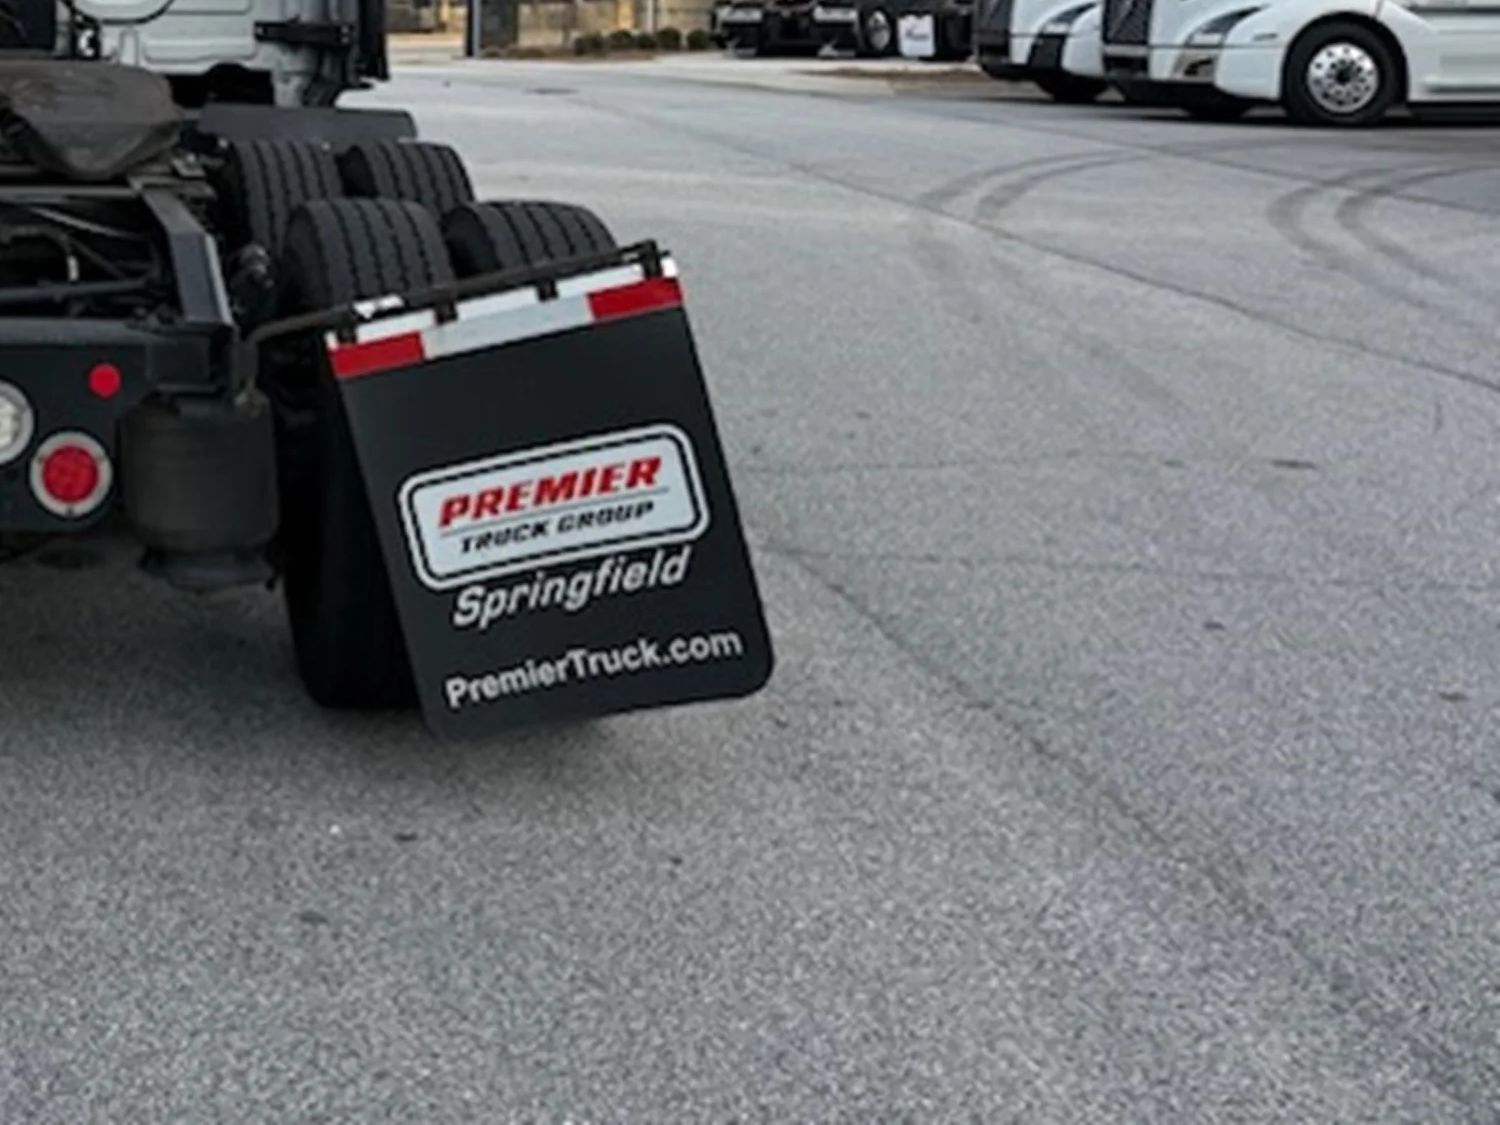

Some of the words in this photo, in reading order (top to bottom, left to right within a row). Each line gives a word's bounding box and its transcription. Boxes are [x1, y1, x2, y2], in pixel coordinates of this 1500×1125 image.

[437, 456, 662, 529] PREMIER
[460, 516, 549, 554] TRUCK
[557, 500, 655, 532] GROUP
[452, 544, 692, 629] Springfield
[445, 629, 744, 708] PremierTruck.com
